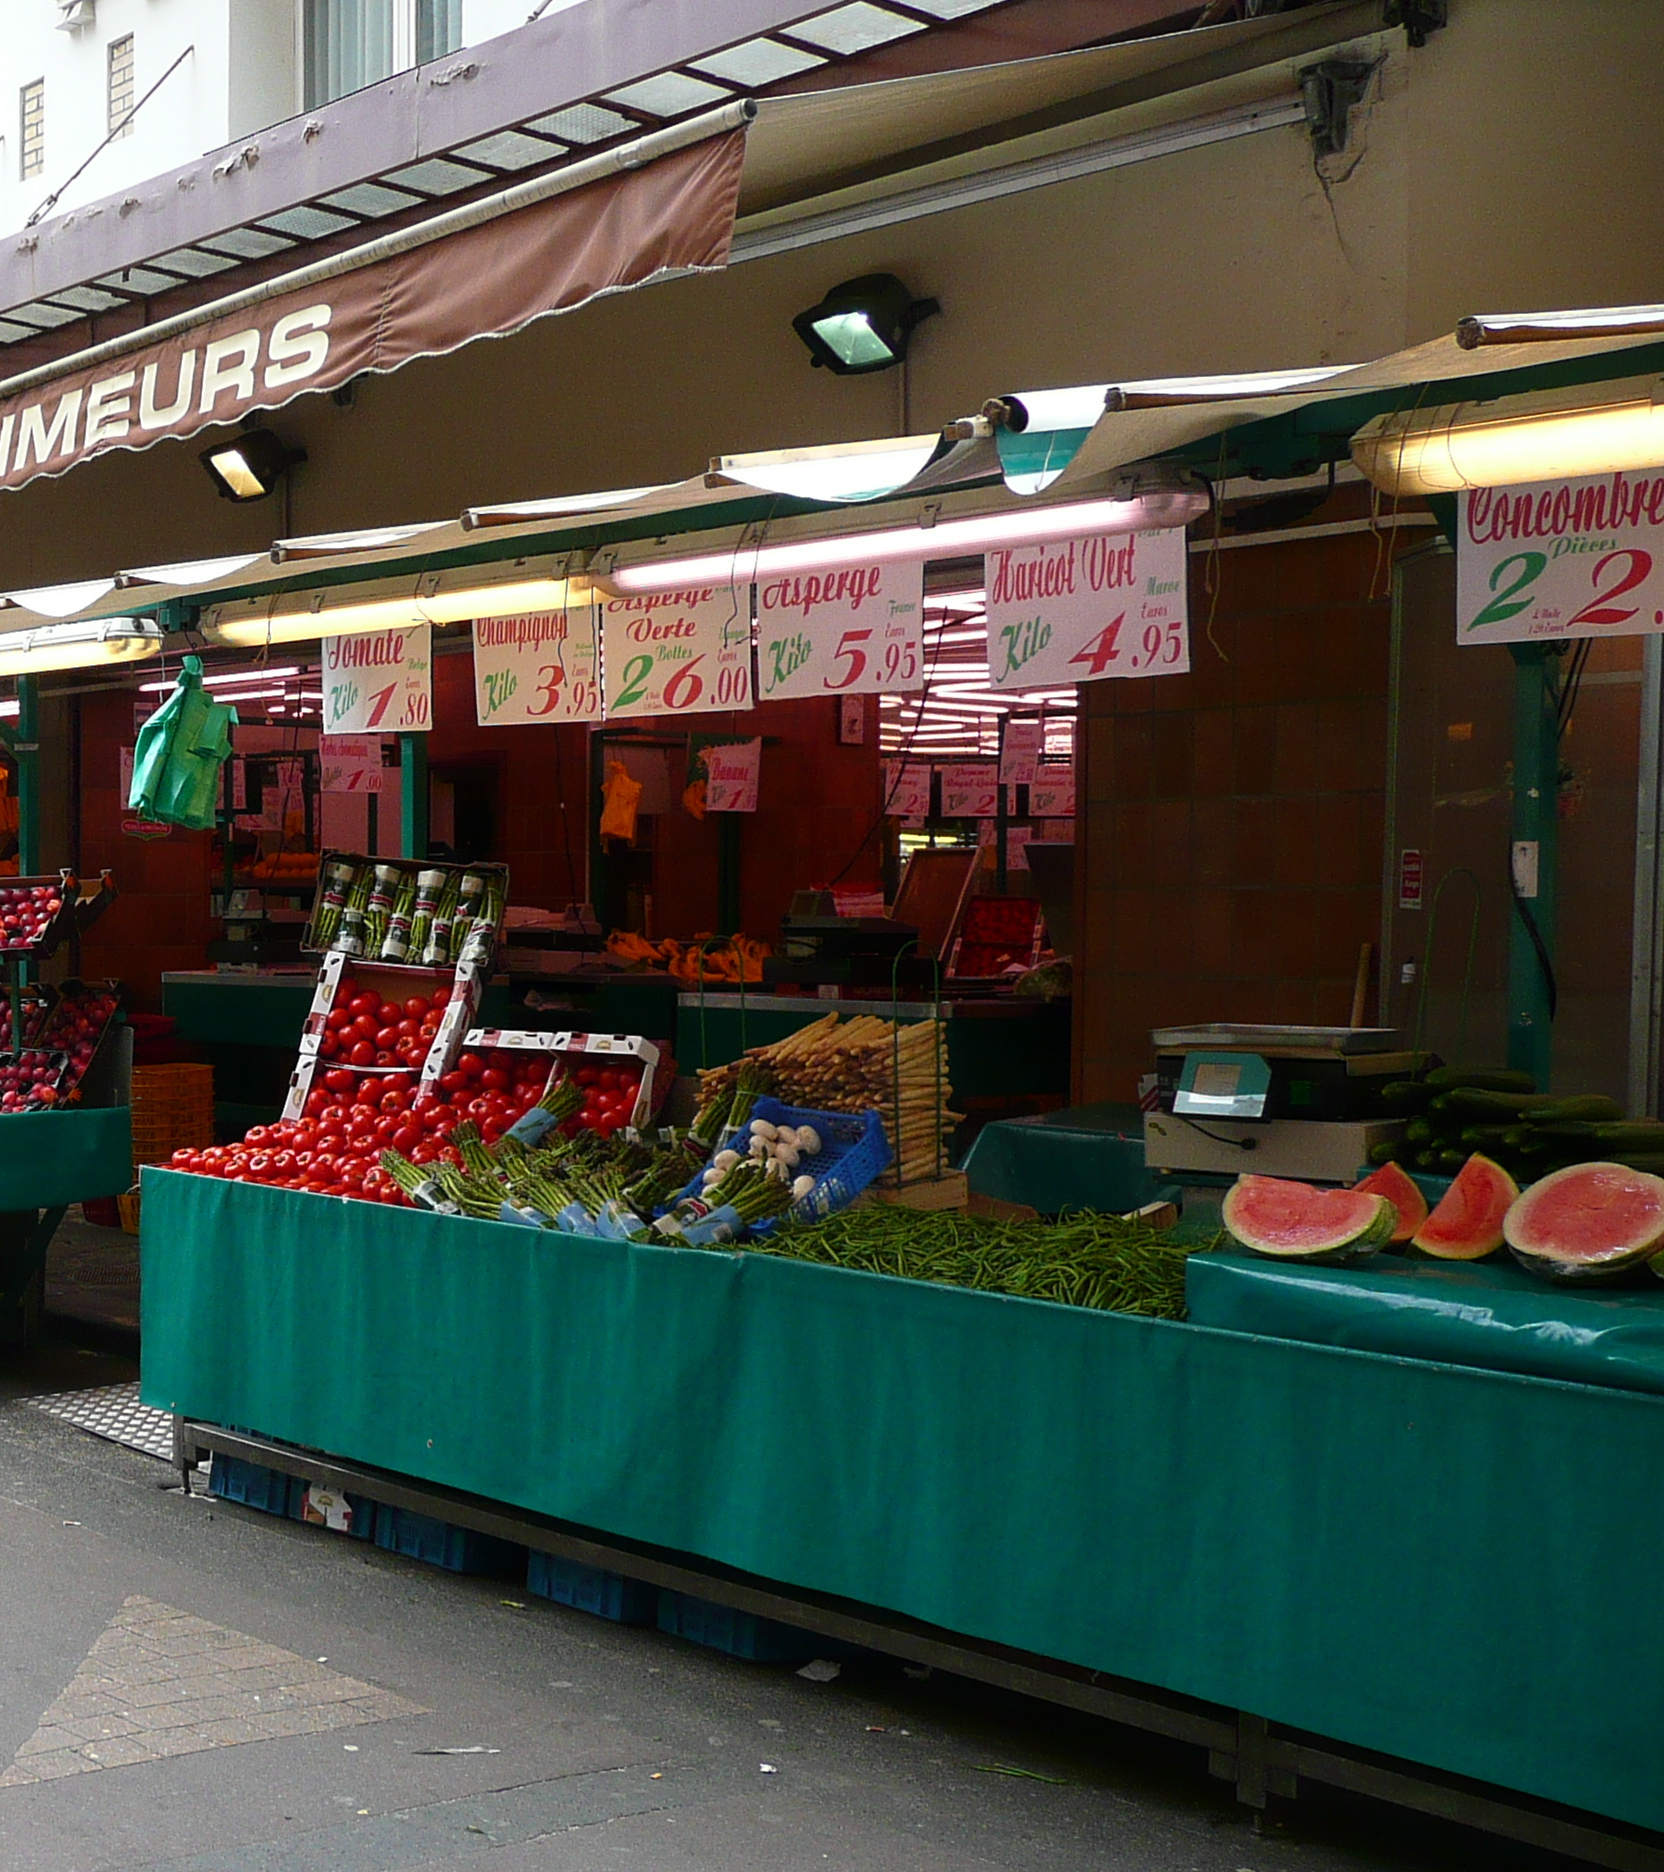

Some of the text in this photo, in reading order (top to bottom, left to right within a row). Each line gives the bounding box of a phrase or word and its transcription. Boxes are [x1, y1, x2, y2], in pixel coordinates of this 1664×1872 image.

[990, 533, 1137, 605] Haricot Vert
[1547, 535, 1620, 560] Pièces
[762, 565, 883, 617] Asperge
[1466, 551, 1548, 633] 2
[328, 629, 405, 671] Tomate
[476, 611, 569, 654] Champignon
[625, 617, 697, 643] Verte
[995, 615, 1052, 684] Kilo
[609, 653, 654, 712] 2
[765, 632, 812, 694] Kilo
[327, 680, 359, 730] Kilo
[481, 668, 518, 721] Kilo
